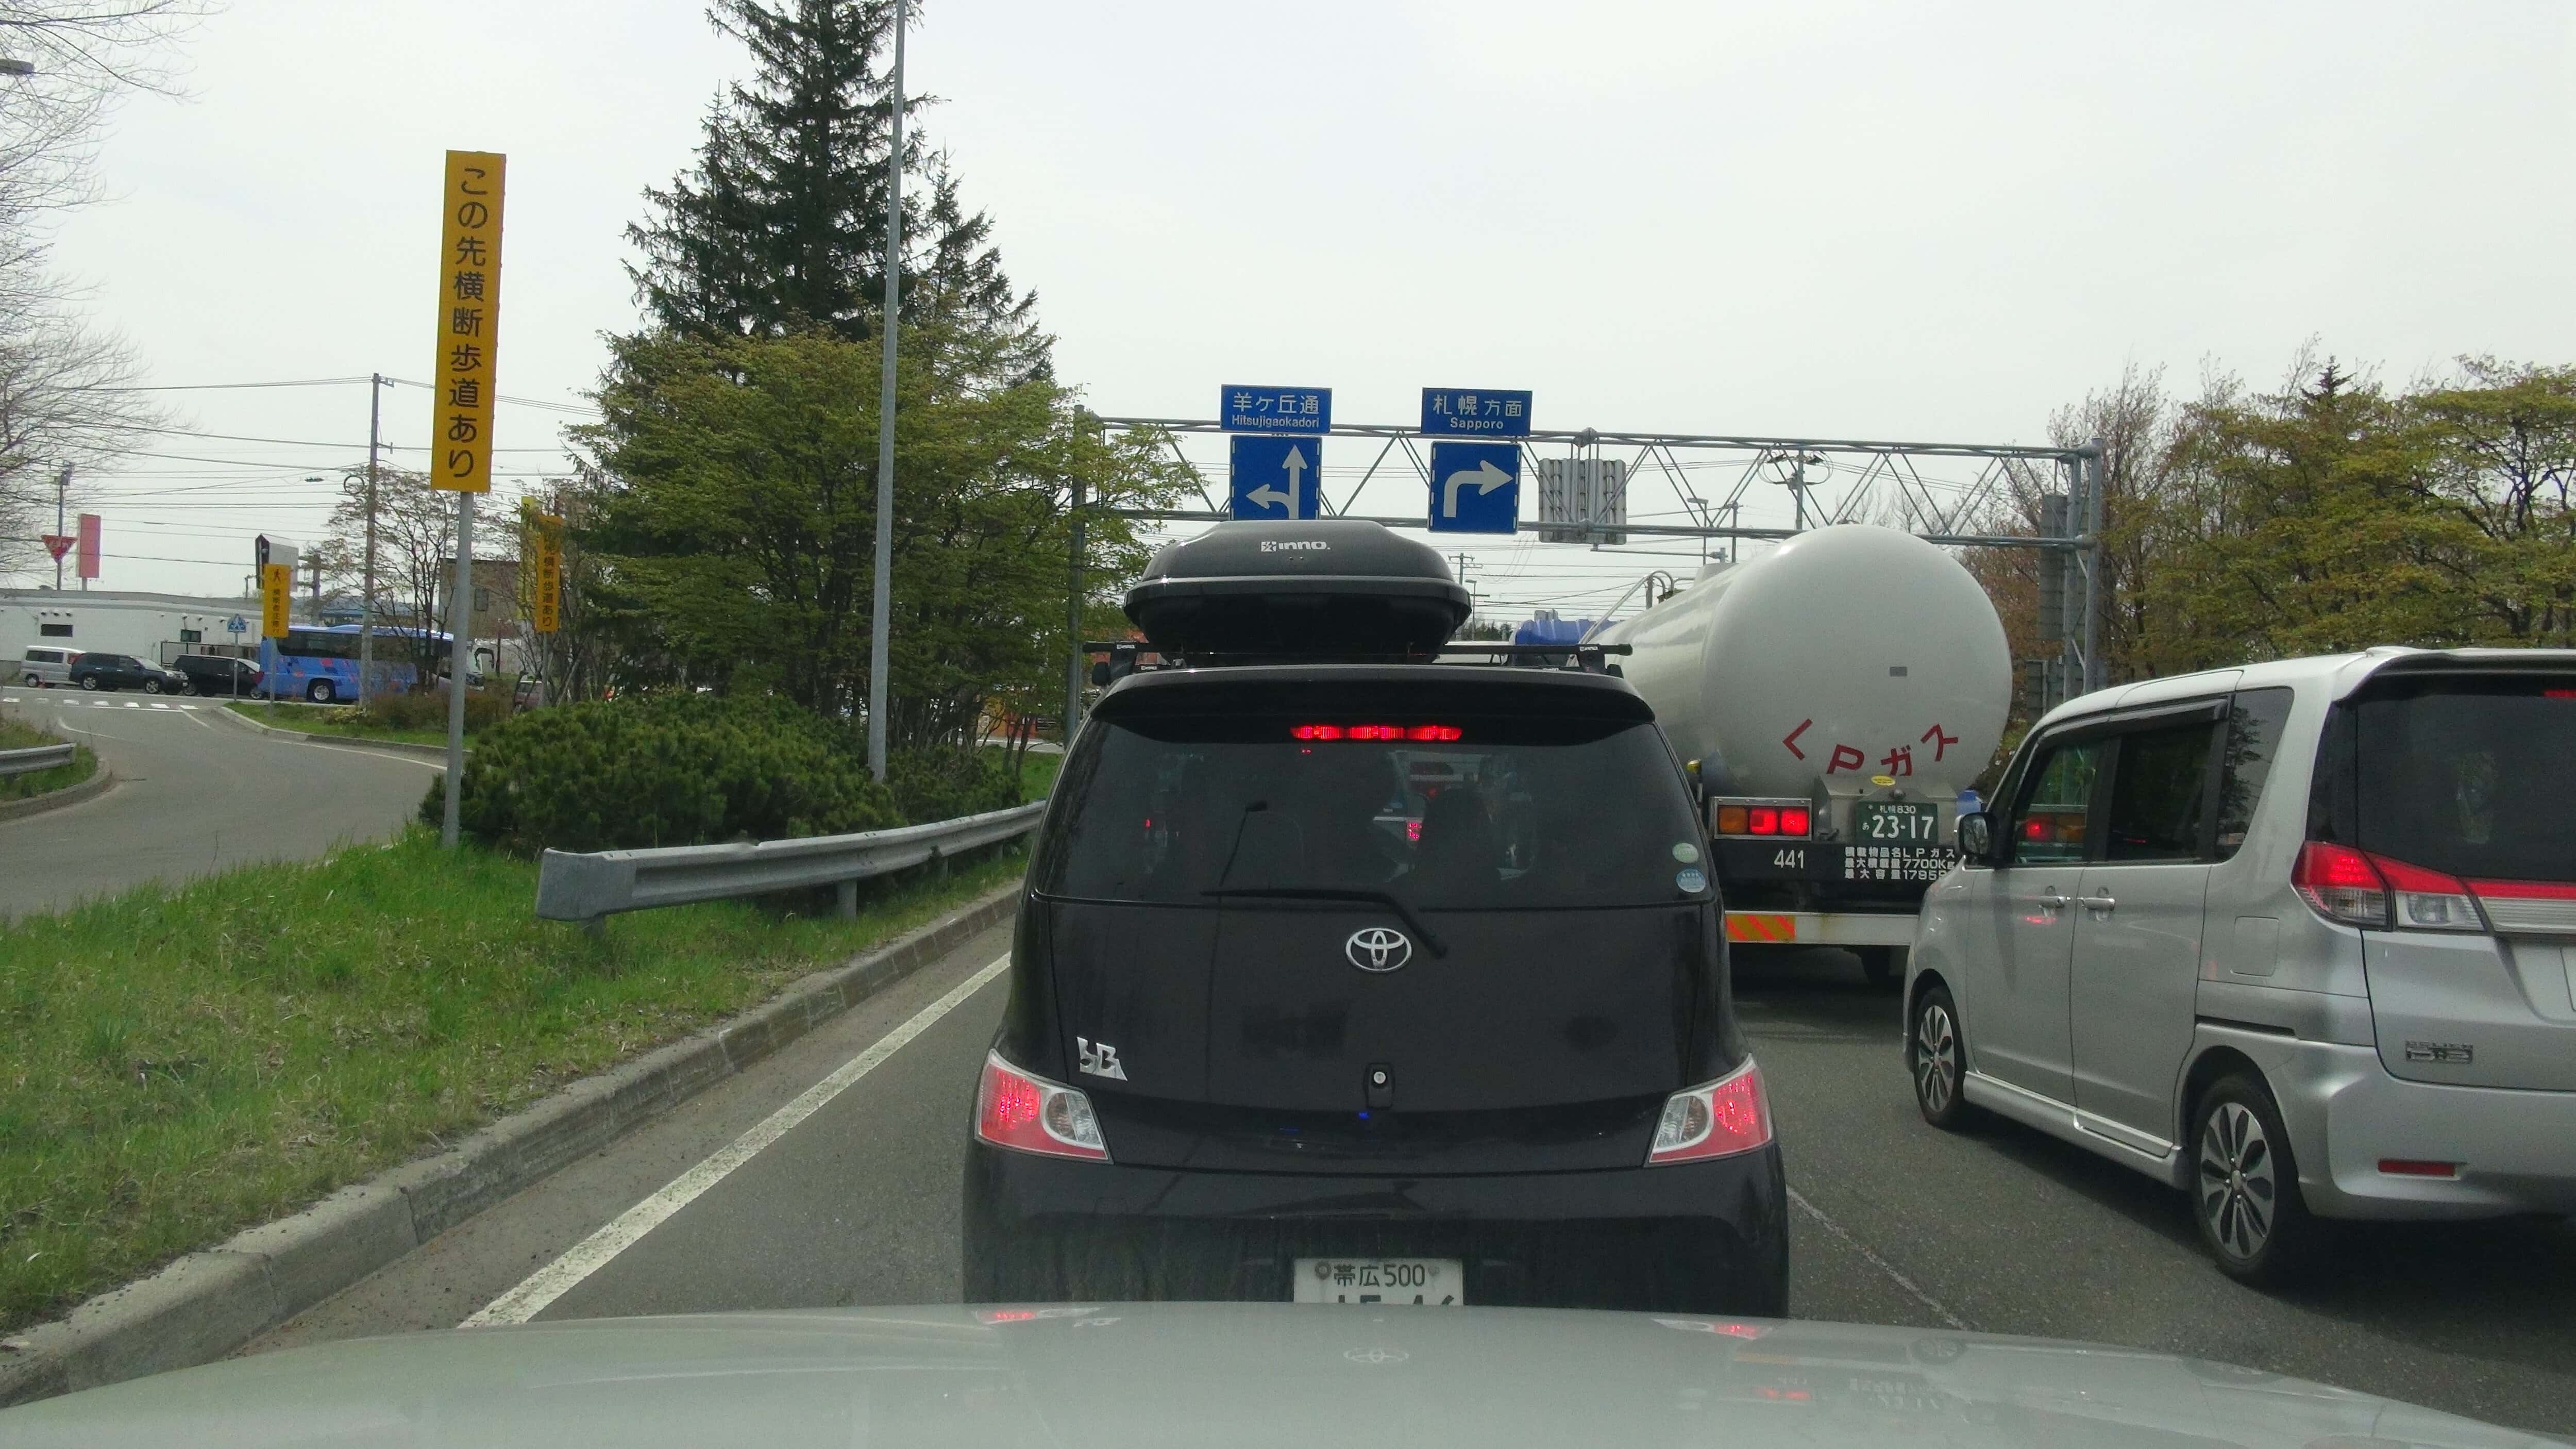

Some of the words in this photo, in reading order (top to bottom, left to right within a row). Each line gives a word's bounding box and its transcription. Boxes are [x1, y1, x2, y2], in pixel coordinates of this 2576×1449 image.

[447, 168, 489, 478] この先横断歩道あり
[1433, 394, 1522, 417] 札幌方面
[1232, 414, 1320, 428] Hitsujigaokadori
[1450, 416, 1504, 431] Sapporo
[1872, 815, 1934, 840] 23-17
[1774, 849, 1804, 869] 441
[1334, 1263, 1426, 1287] 帯広500
